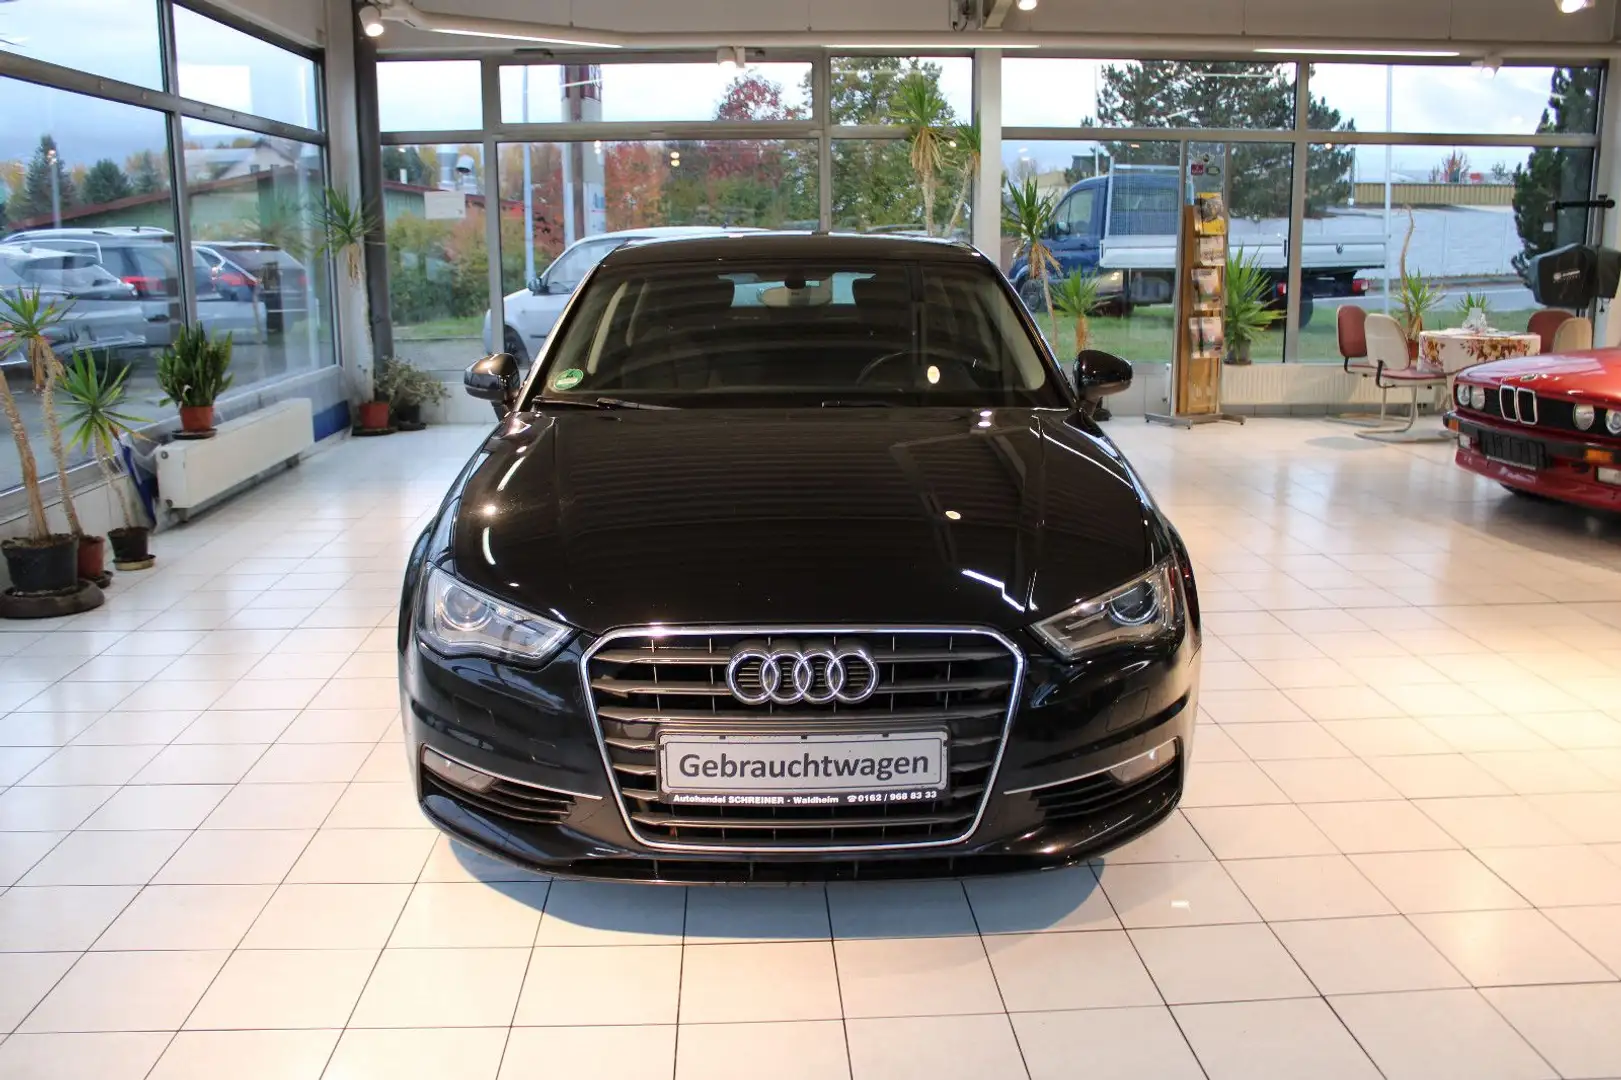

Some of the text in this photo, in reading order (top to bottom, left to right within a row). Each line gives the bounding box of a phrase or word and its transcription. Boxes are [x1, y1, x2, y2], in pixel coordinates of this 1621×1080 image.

[679, 753, 928, 781] Gebrauchtwagen
[673, 795, 726, 804] Autohandel
[728, 796, 784, 804] SCHREINER
[793, 796, 839, 805] Waldheim
[858, 794, 882, 802] 0162
[925, 790, 937, 799] 33
